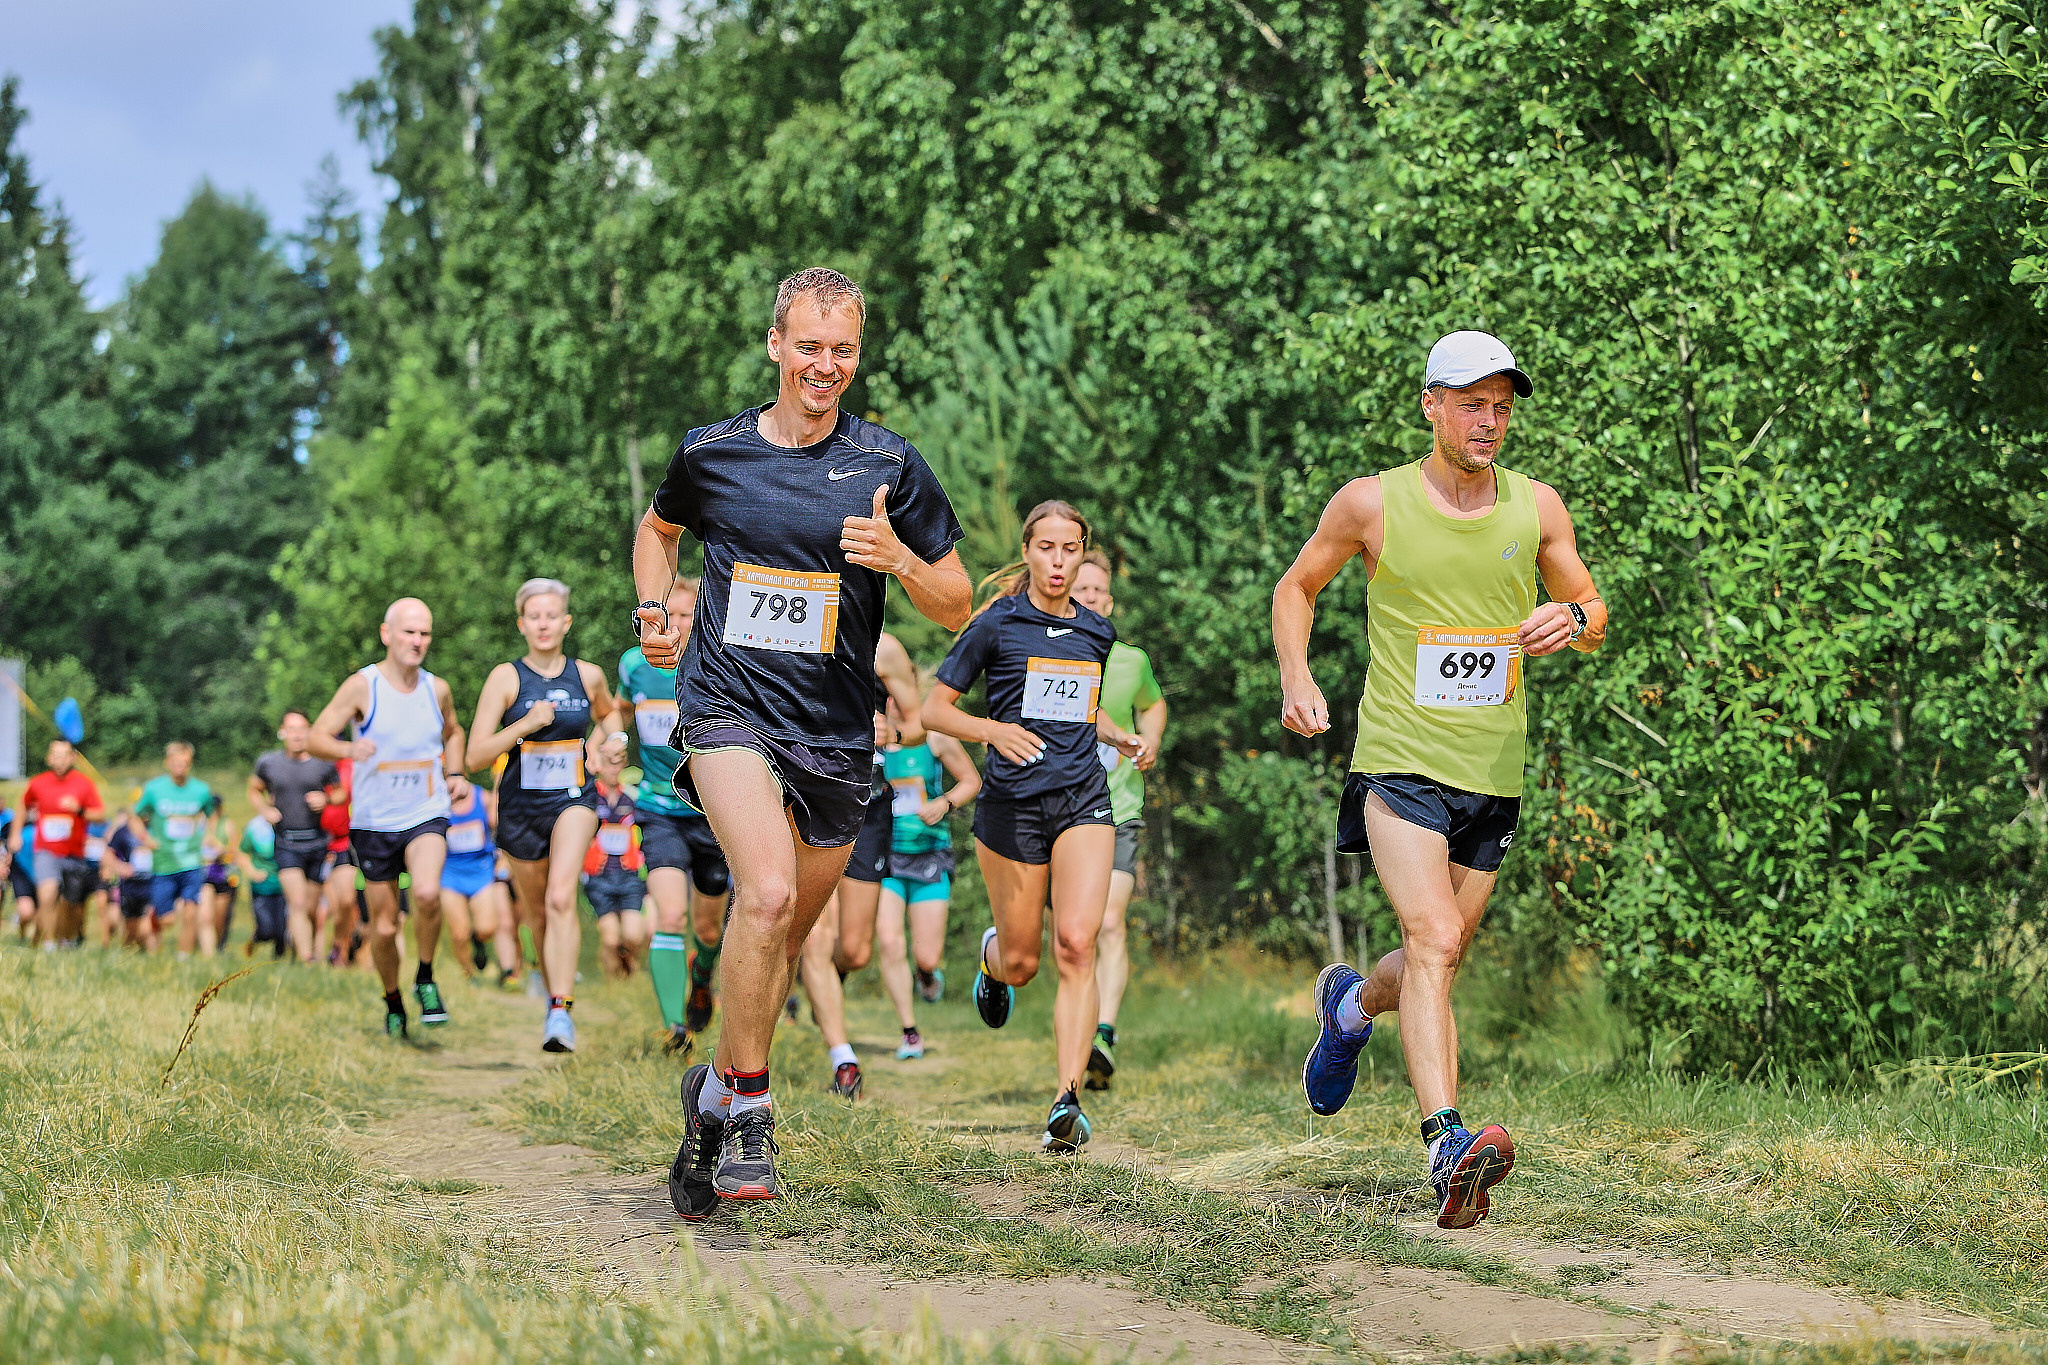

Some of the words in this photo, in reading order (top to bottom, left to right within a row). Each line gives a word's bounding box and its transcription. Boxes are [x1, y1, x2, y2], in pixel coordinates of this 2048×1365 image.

[749, 590, 808, 624] 798
[824, 607, 832, 647] CLASSIC
[1439, 651, 1496, 679] 699
[1043, 678, 1079, 699] 742
[536, 756, 566, 771] 794
[391, 772, 420, 788] 779
